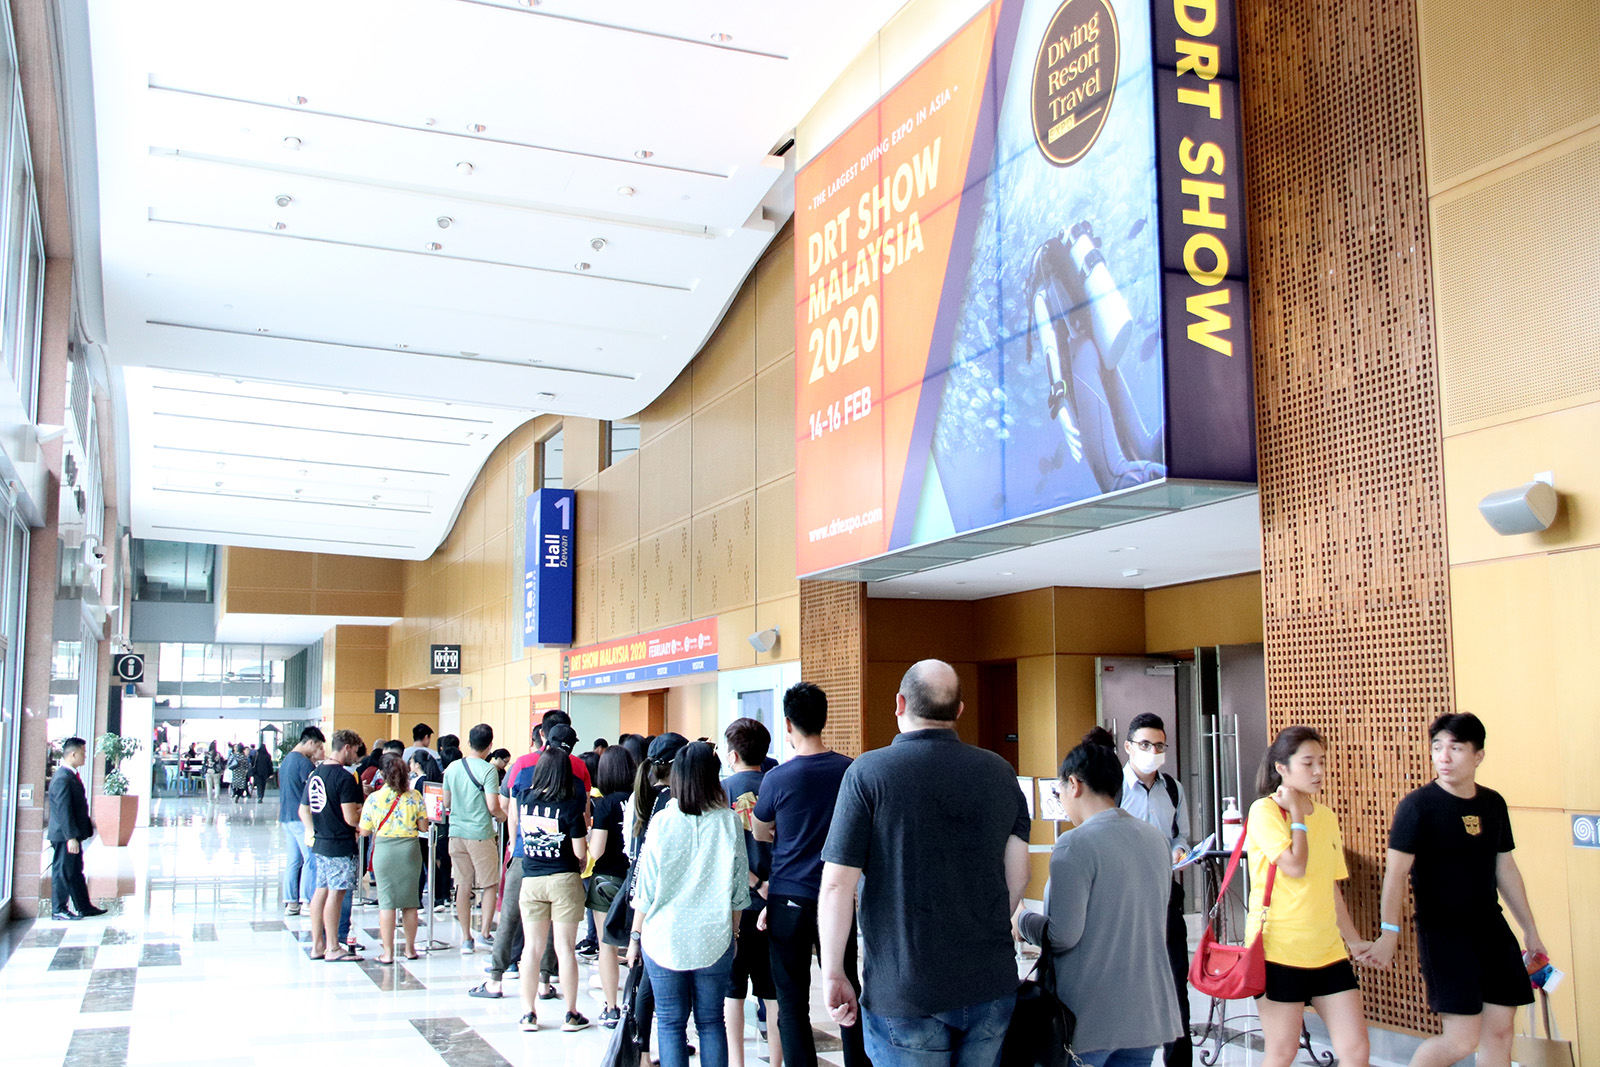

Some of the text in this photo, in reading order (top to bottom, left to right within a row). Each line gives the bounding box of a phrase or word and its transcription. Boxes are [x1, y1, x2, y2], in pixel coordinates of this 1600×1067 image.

[1047, 12, 1099, 68] Diving
[1048, 42, 1100, 96] Resort
[1048, 68, 1101, 122] Travel
[812, 89, 950, 209] THE LARGEST DIVING EXPO IN ASIA
[1049, 116, 1074, 140] EXPO
[1173, 0, 1232, 357] DRT SHOW
[808, 136, 941, 277] DRT SHOW
[807, 211, 924, 324] MALAYSIA
[808, 294, 879, 384] 2020
[809, 386, 872, 441] 14-16 FEB
[554, 497, 571, 530] 1
[808, 508, 883, 543] www.drtexpo.com
[544, 534, 560, 568] Hall
[560, 535, 568, 568] Dewan
[570, 654, 581, 672] DRT
[582, 650, 599, 670] SHOW
[599, 644, 629, 667] MALAYSIA
[630, 641, 647, 662] 2020
[520, 804, 560, 819] MAUI
